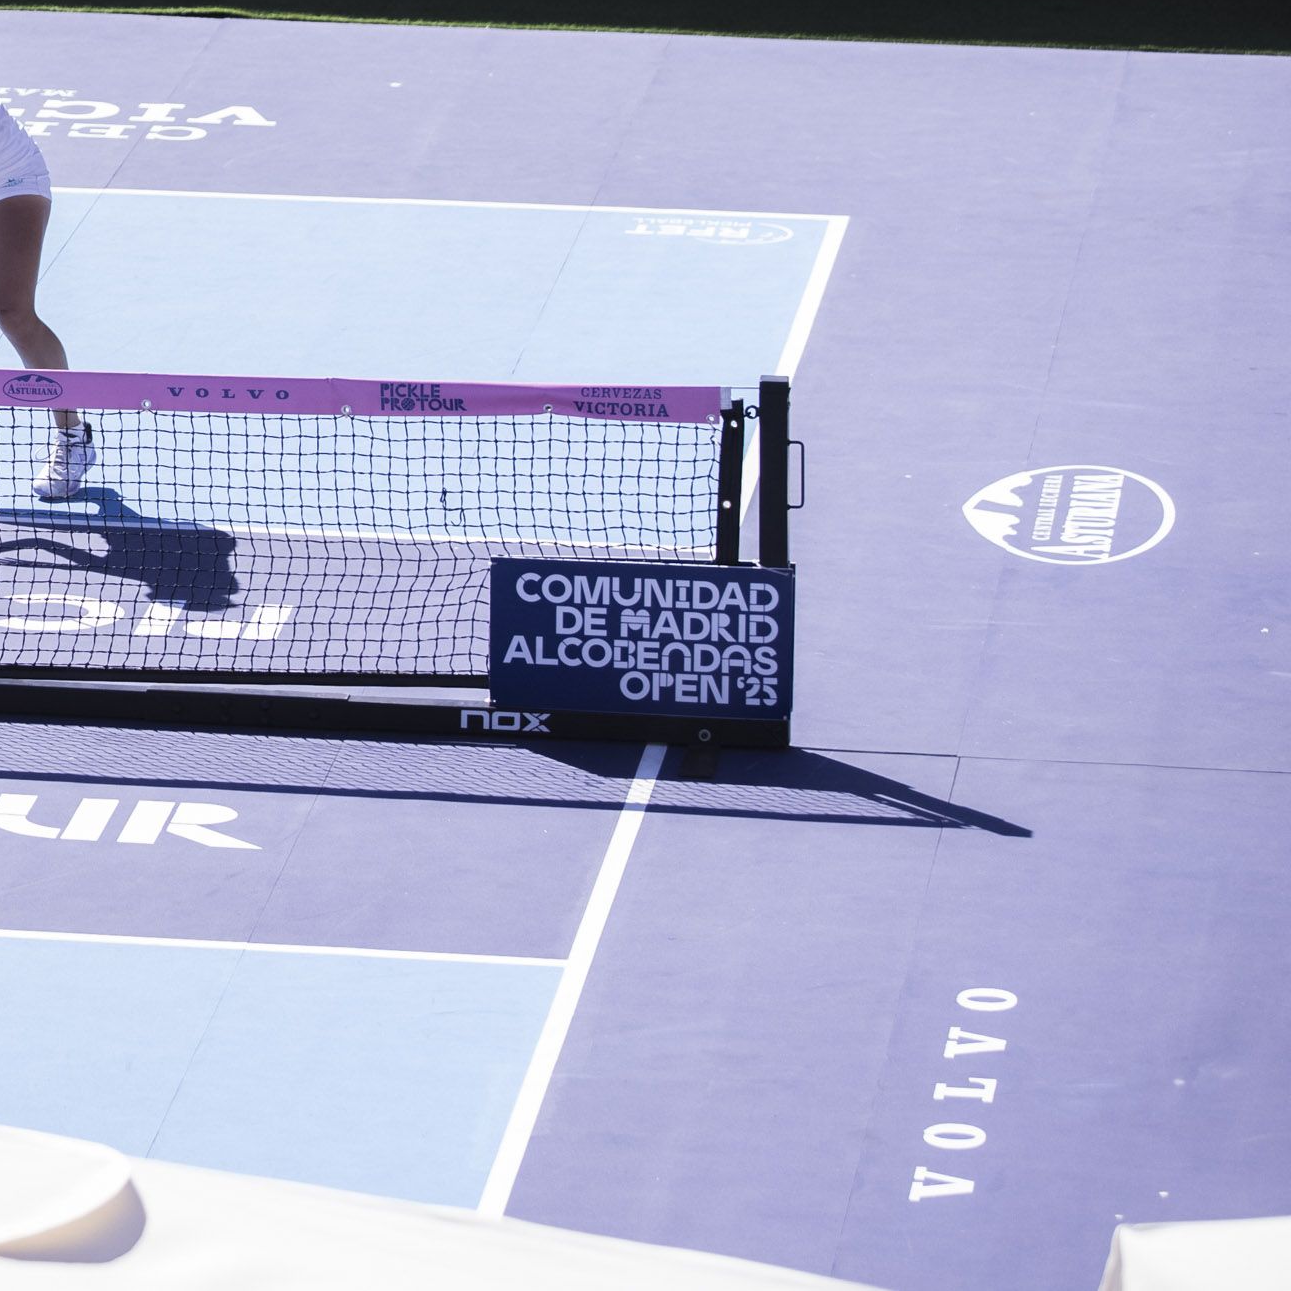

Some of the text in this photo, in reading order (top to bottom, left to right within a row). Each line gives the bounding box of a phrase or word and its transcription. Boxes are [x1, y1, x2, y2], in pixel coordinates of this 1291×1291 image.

[623, 222, 752, 239] RFET
[7, 383, 59, 398] ASTURIANA
[167, 387, 291, 401] VOLVO
[380, 383, 441, 400] PICKLE
[580, 387, 664, 402] CERVEZAS
[573, 401, 671, 418] VICTORIA
[1030, 474, 1125, 559] ASTURIANA
[515, 572, 779, 612] COMUNIDAD
[555, 605, 779, 643] DE MADRID
[502, 635, 779, 676] ALCOBENDAS
[619, 671, 730, 704] OPEN
[908, 987, 1019, 1203] VOLVO
